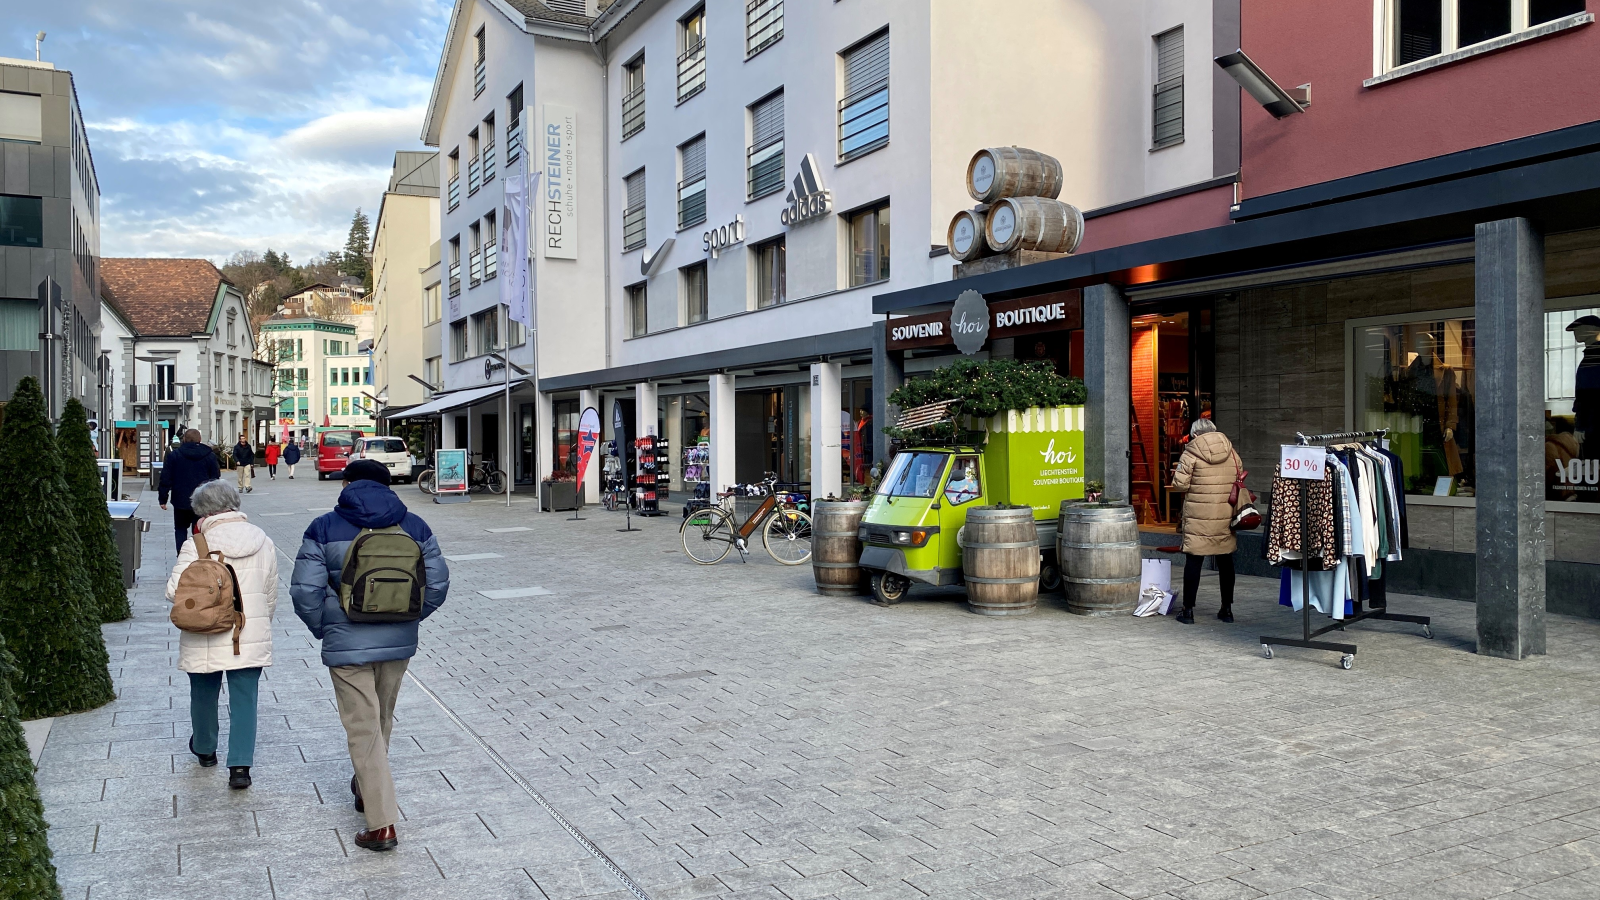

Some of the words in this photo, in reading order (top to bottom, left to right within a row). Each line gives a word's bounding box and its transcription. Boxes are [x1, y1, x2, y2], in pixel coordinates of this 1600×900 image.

[565, 116, 575, 141] sport
[565, 151, 573, 176] mode
[547, 124, 562, 249] RECHSTEINER
[566, 184, 574, 217] schuhe
[780, 193, 832, 226] adidas
[703, 214, 744, 258] sport
[892, 321, 943, 341] SOUVENIR
[954, 311, 984, 335] hoi
[996, 302, 1066, 328] BOUTIQUE
[1040, 438, 1076, 464] hoi
[1040, 468, 1078, 476] LIECHTENSTEIN
[1284, 458, 1300, 470] 30
[1304, 459, 1317, 471] %
[1555, 458, 1600, 484] YOU
